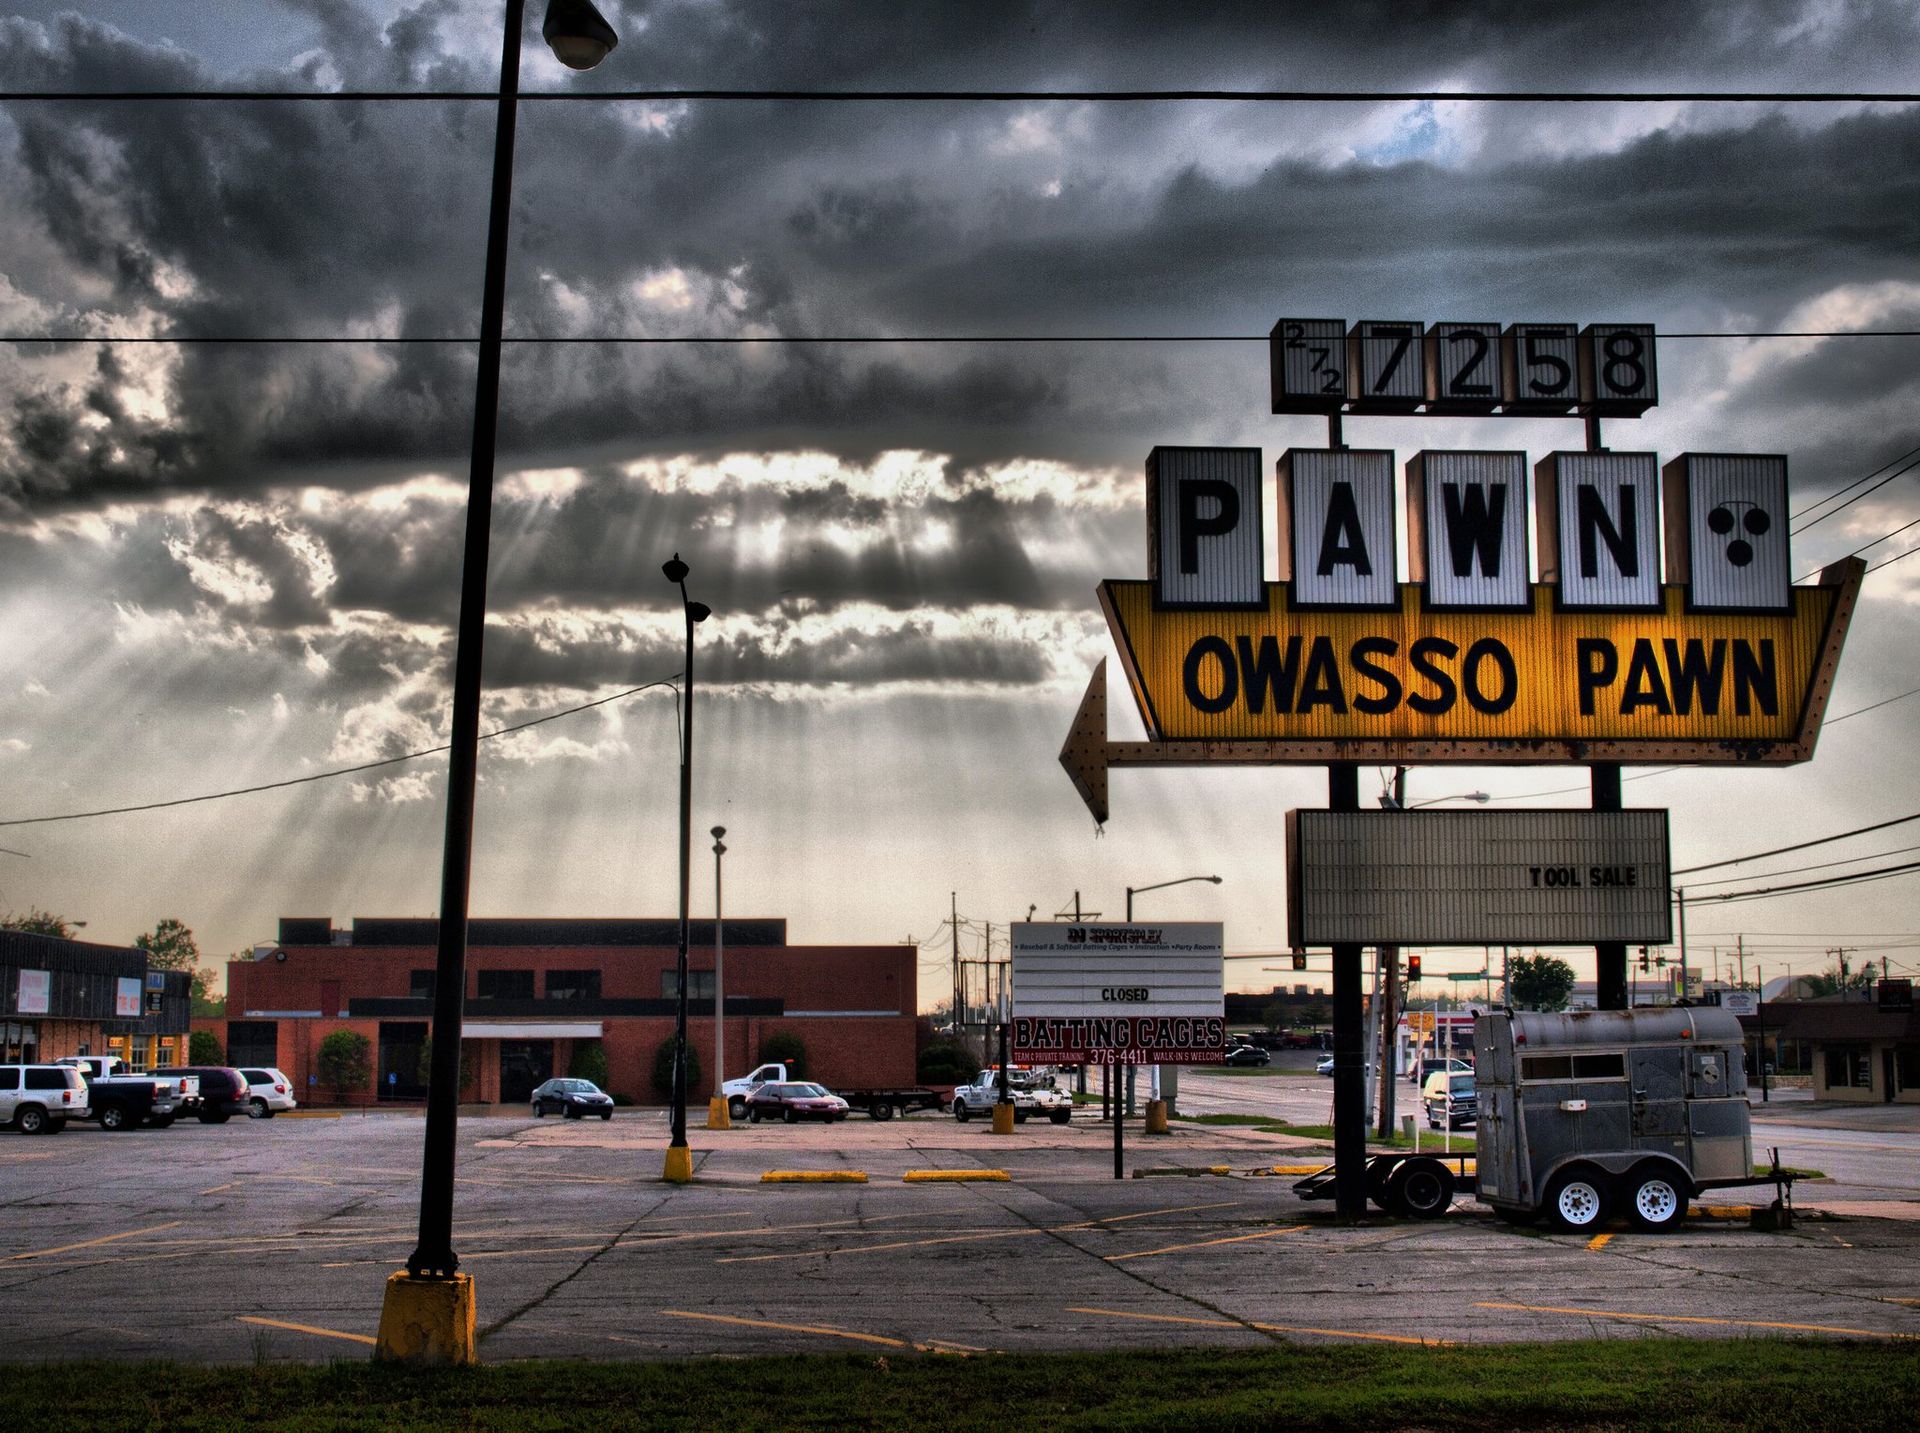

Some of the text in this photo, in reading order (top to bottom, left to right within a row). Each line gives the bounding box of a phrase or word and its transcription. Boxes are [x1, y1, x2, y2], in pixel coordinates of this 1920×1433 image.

[1179, 479, 1639, 578] PAWN
[1183, 635, 1779, 716] OWASSO PAWN
[1529, 866, 1636, 887] TOOL SALE
[1102, 988, 1149, 1001] CLOSED
[1014, 1018, 1224, 1048] BATTING CAGES
[1014, 1052, 1030, 1061] TEAM
[1035, 1052, 1058, 1061] PRIVATE
[1059, 1052, 1084, 1061] TRAINING
[1090, 1049, 1147, 1064] 376-4411
[1190, 1051, 1225, 1061] WELCOME
